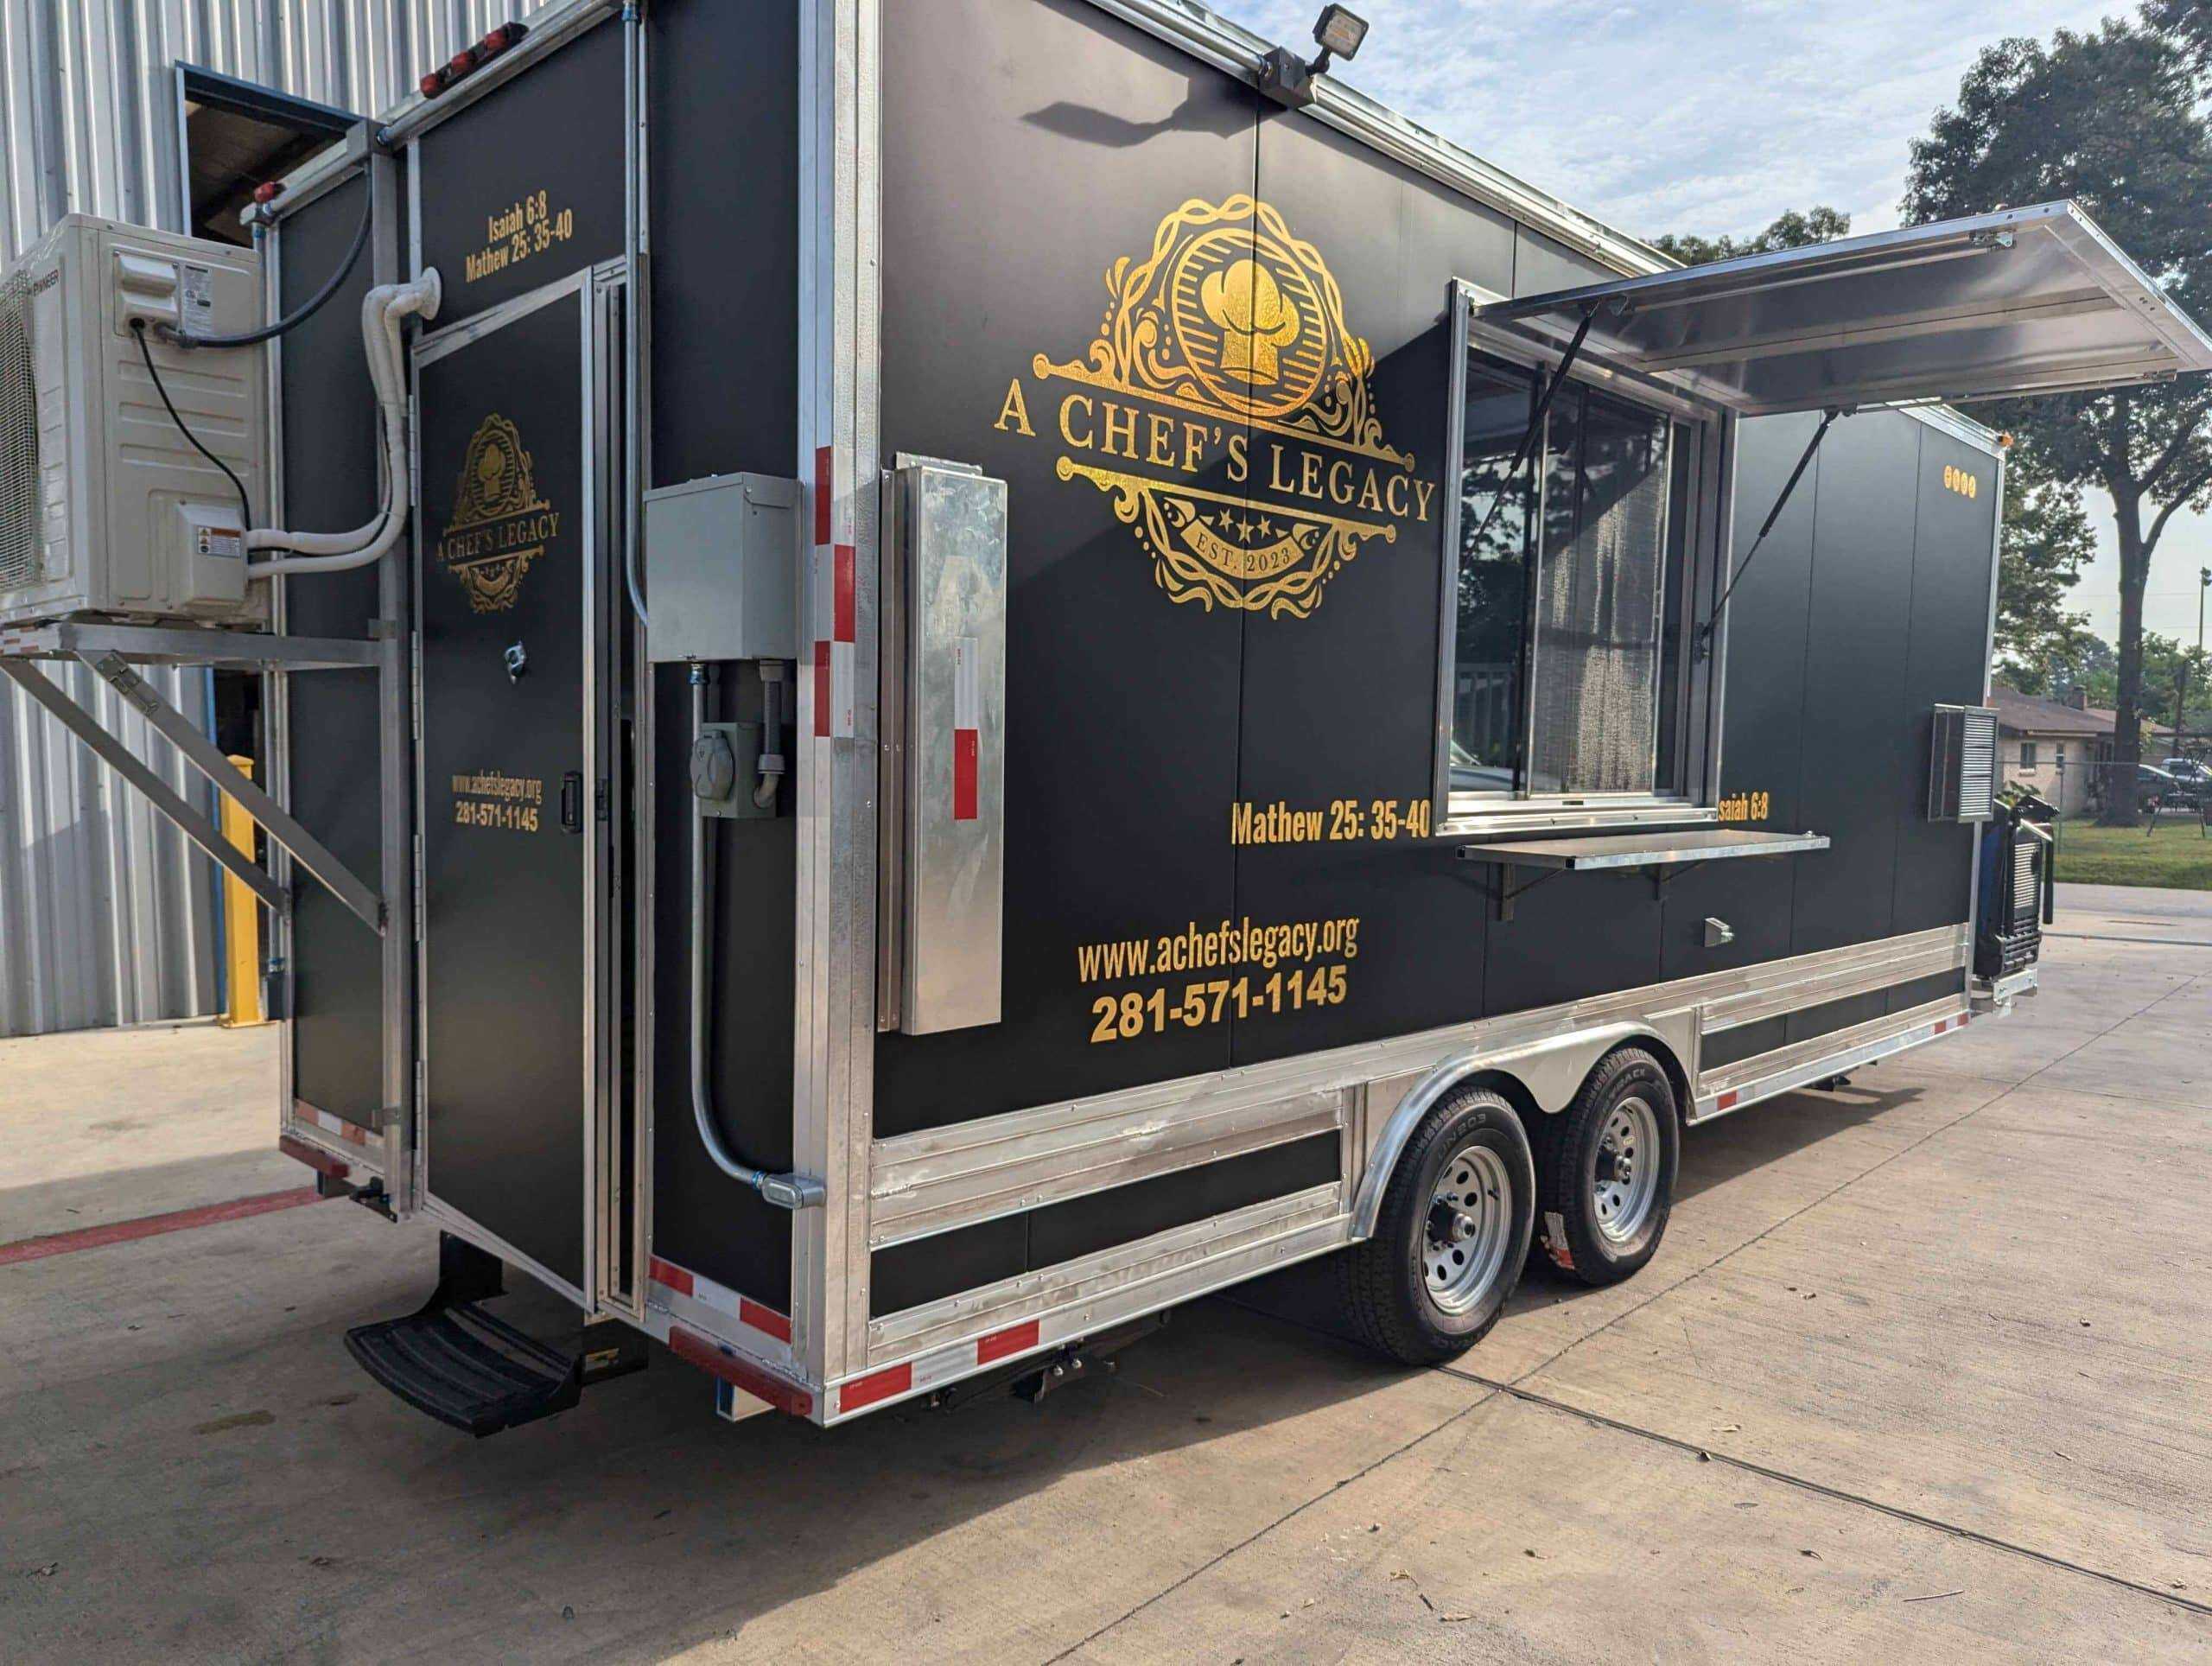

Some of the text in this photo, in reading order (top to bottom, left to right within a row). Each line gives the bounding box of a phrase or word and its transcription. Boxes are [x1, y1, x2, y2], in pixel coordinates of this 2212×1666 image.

[487, 189, 547, 244] Isaiah 6:8
[466, 208, 573, 283] Mathew 25: 35-40
[994, 378, 1437, 521] A CHEF'S LEGACY
[436, 512, 560, 563] A CHEF'S LEGACY
[1195, 531, 1291, 572] EST. 2023
[454, 799, 539, 833] 281-571-1145
[1231, 798, 1432, 846] Mathew 25: 35-40
[1718, 791, 1770, 822] saiah 6:8
[1077, 915, 1360, 983] www.achefslegacy.org
[1089, 963, 1348, 1045] 281-571-1145
